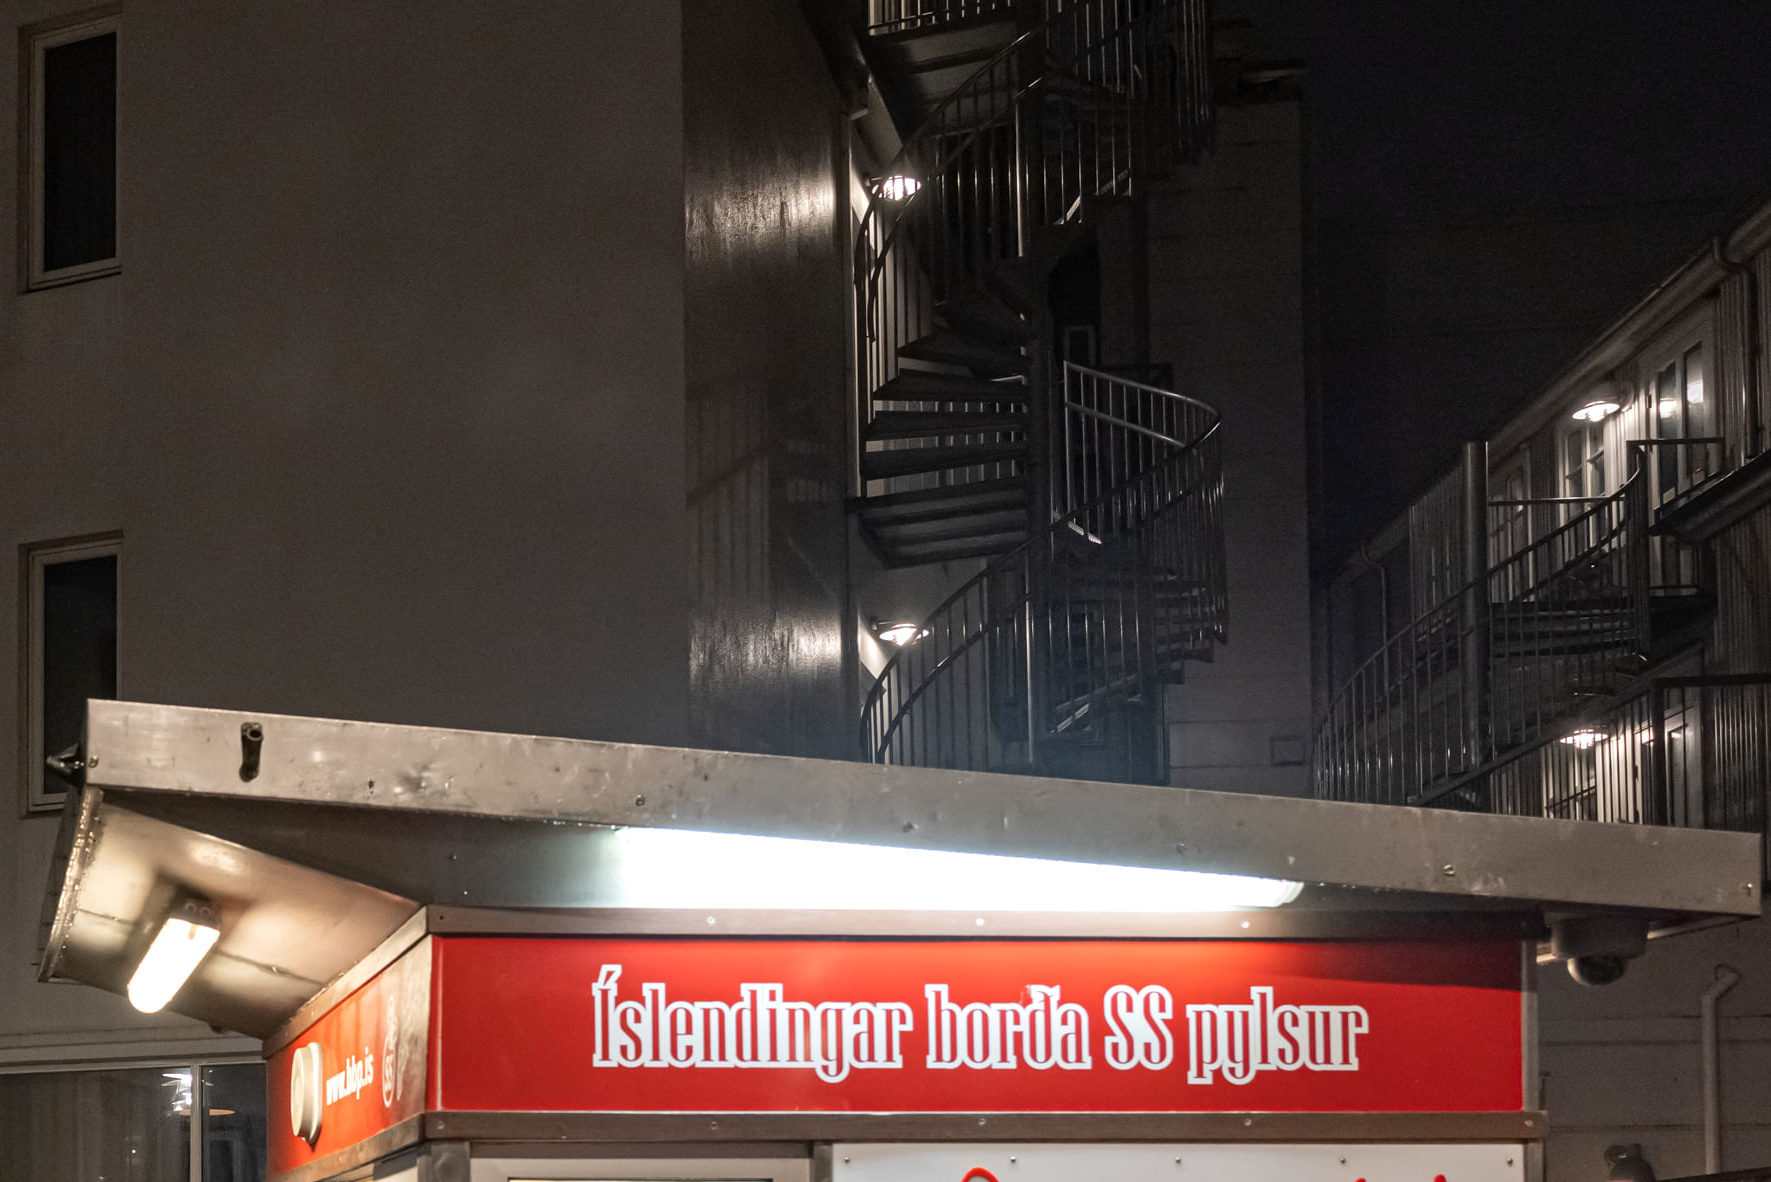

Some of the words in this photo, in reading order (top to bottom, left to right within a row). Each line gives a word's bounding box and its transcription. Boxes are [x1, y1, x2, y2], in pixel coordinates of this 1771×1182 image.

[591, 963, 914, 1084] Íslendingar
[923, 983, 1093, 1071] borða
[1103, 983, 1174, 1071] SS
[1185, 985, 1369, 1086] pylsur
[325, 1046, 375, 1107] www.bbp.is
